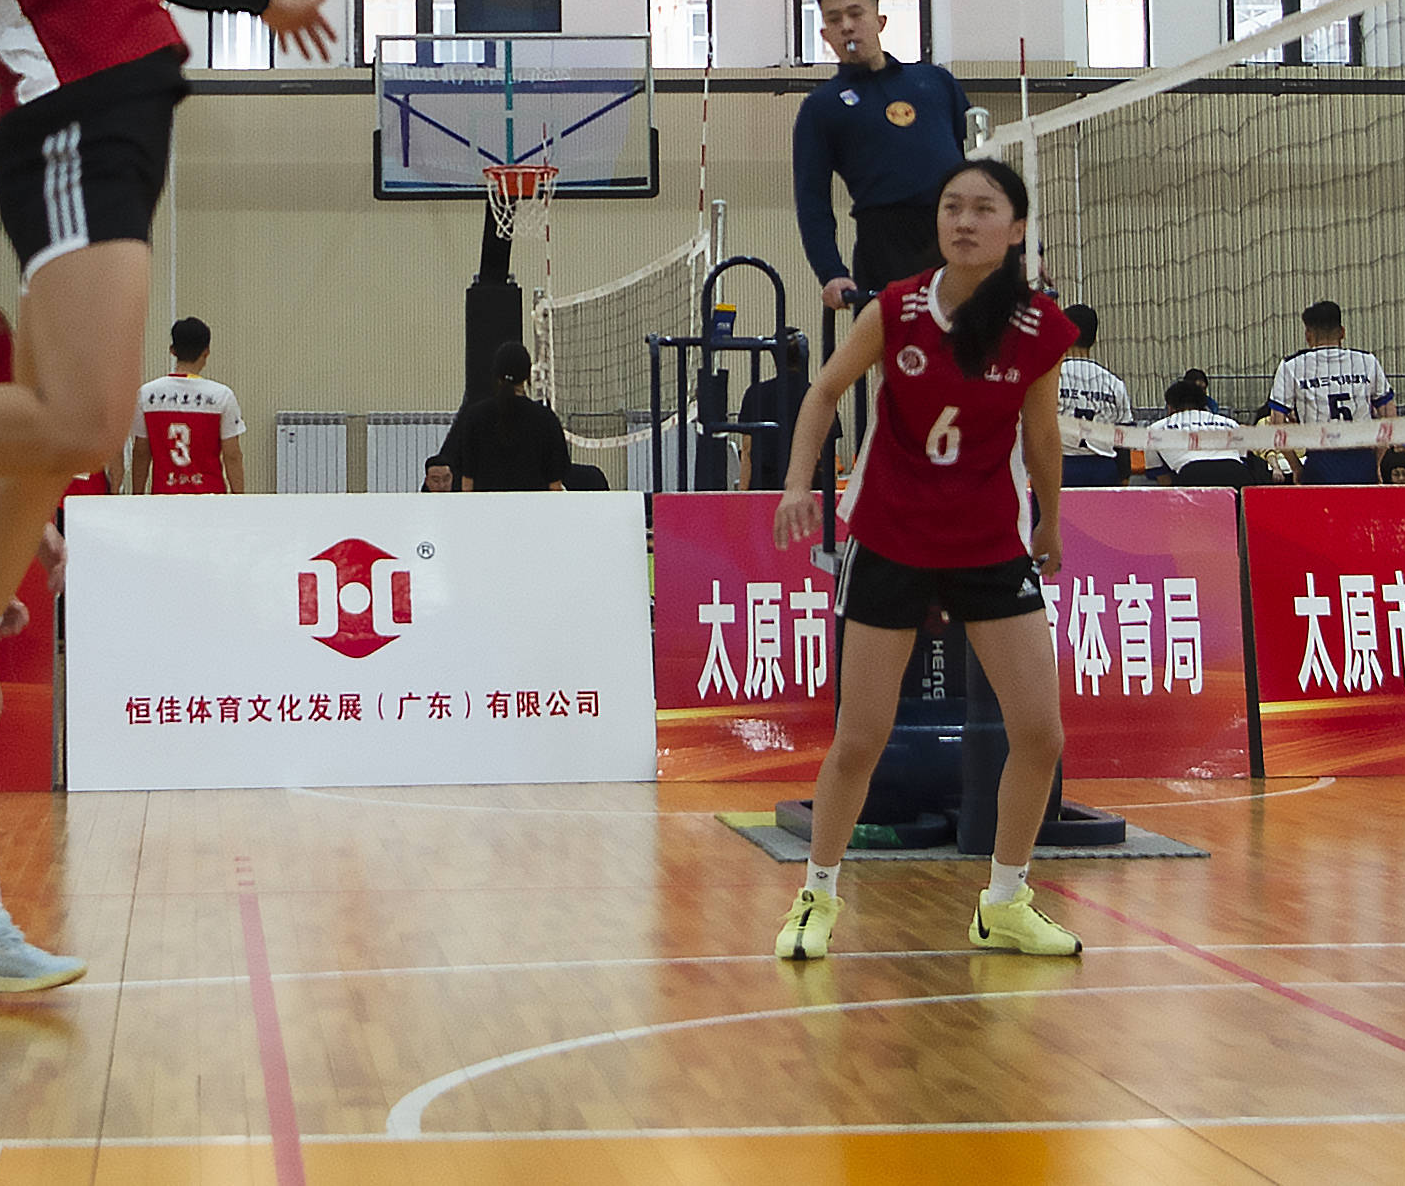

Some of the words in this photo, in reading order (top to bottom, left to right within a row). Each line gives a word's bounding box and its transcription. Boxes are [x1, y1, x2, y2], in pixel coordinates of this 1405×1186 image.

[168, 425, 192, 467] 3
[925, 405, 961, 465] 6
[126, 689, 602, 725] 恒佳体育文化发展（广东）有限公司
